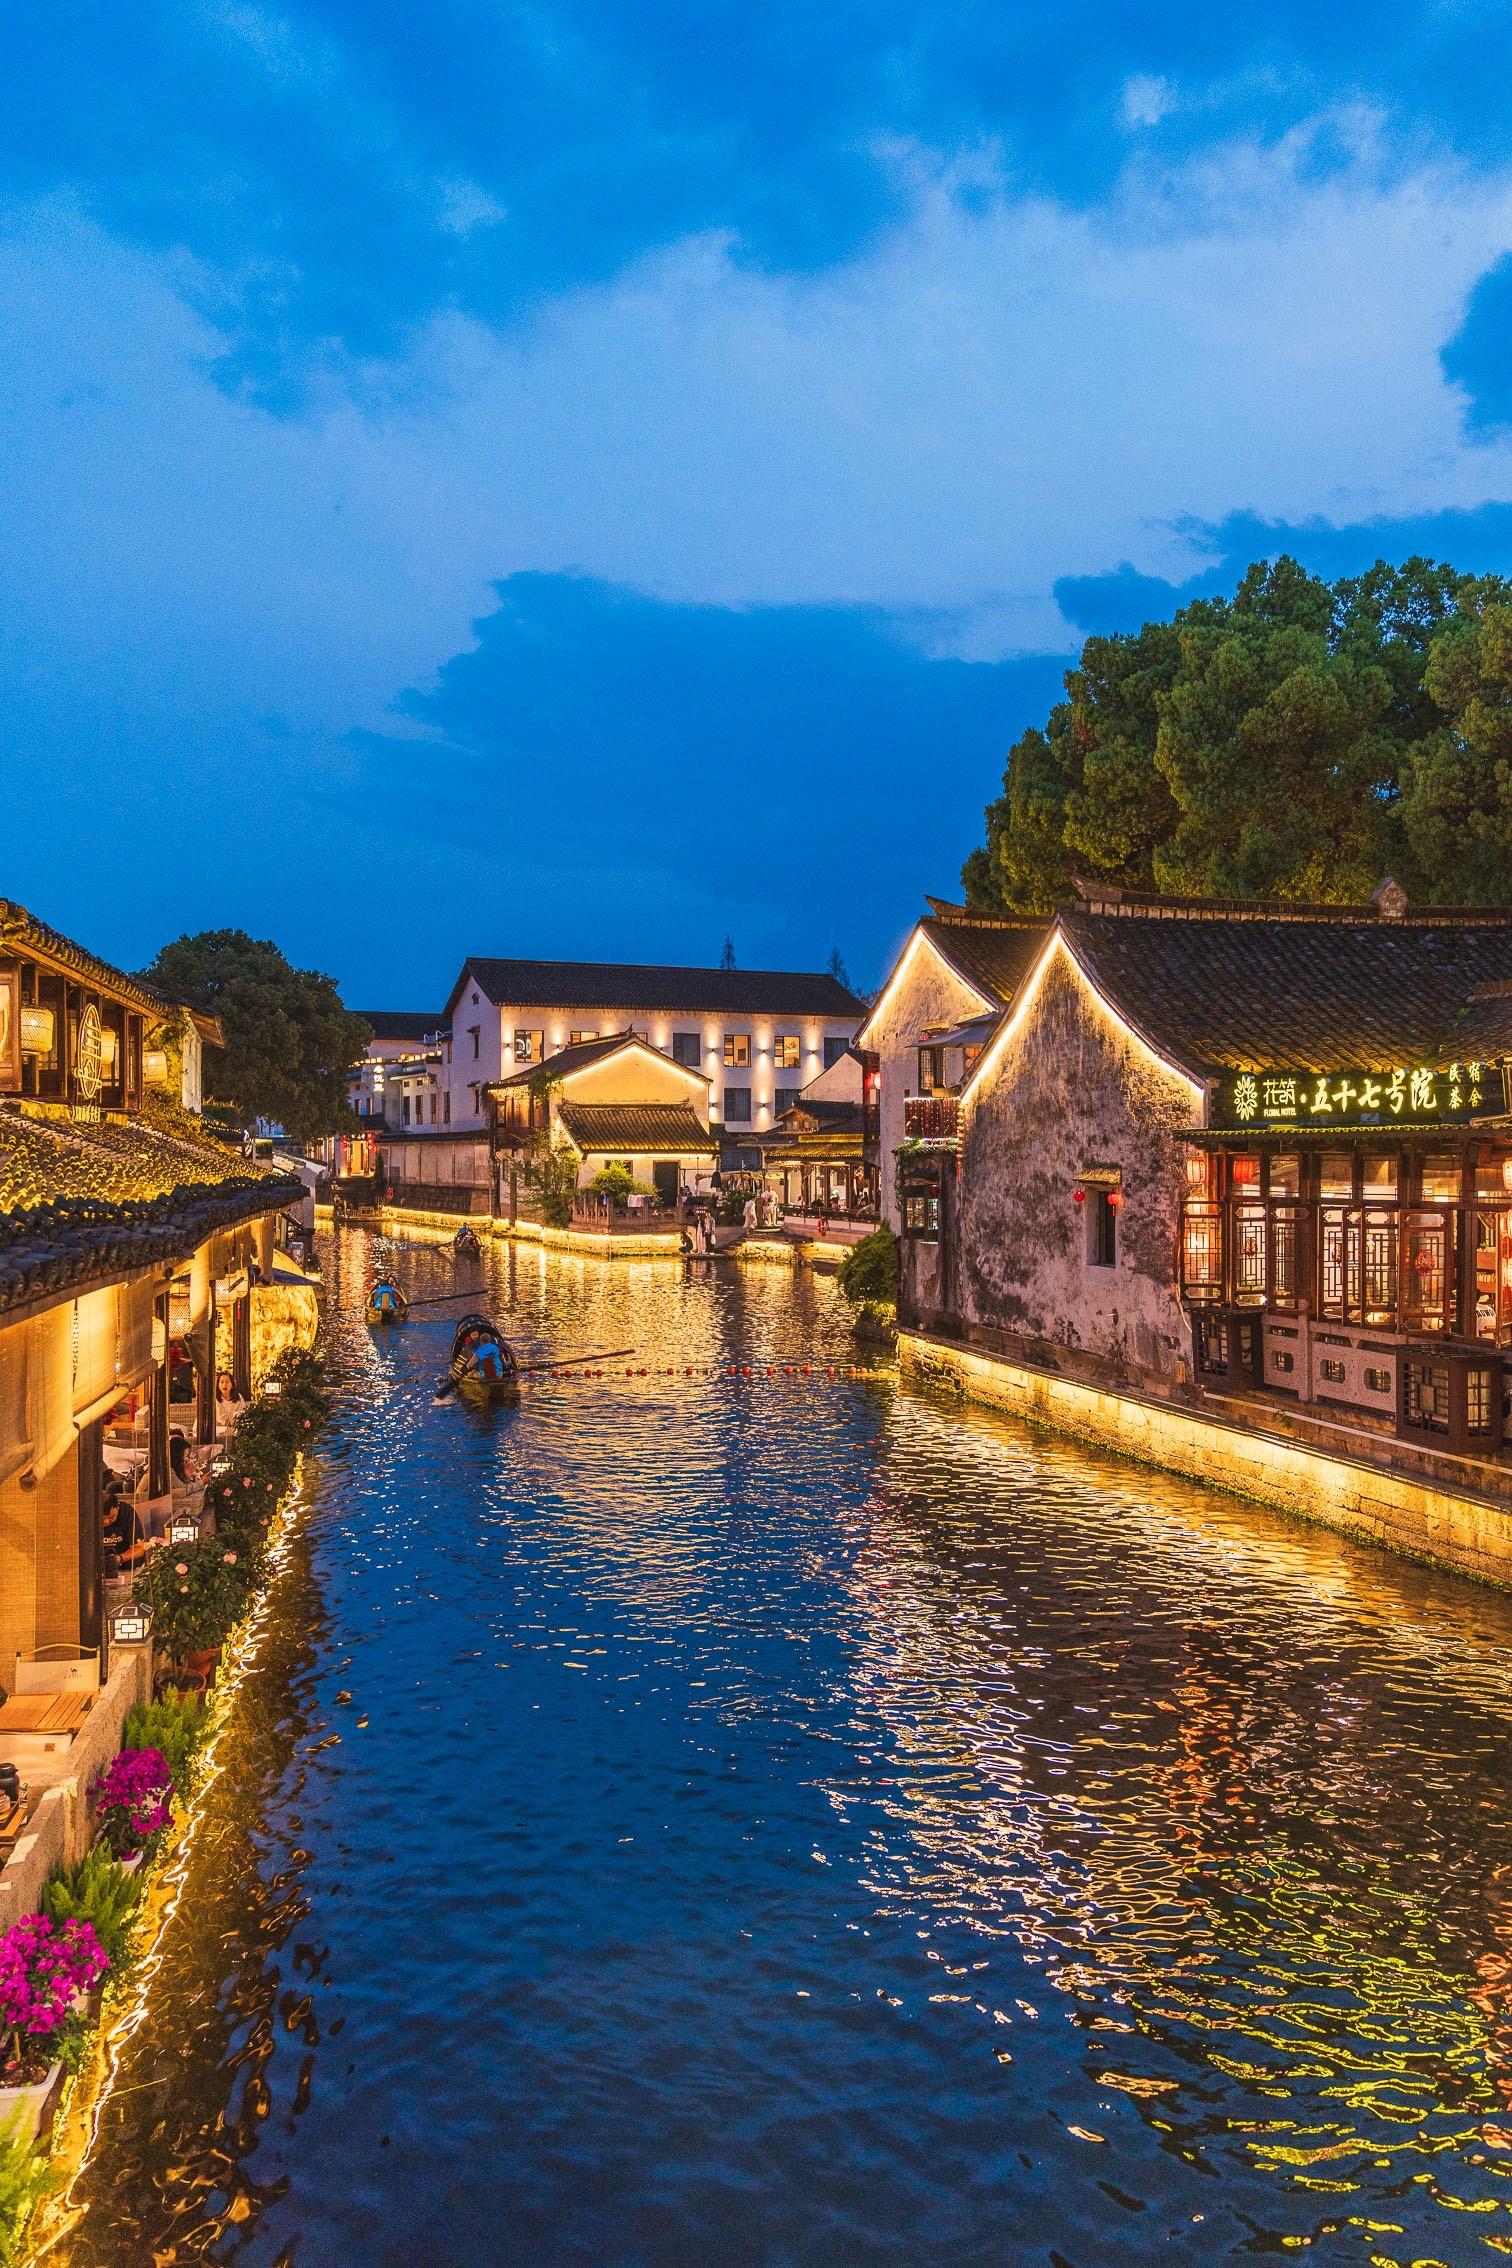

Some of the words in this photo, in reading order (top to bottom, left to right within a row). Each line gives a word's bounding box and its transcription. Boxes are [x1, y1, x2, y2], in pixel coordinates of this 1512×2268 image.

[1449, 1062, 1480, 1083] 民宿
[1263, 1078, 1296, 1105] 花筑
[1310, 1067, 1437, 1113] 五十七号院
[1448, 1086, 1483, 1109] 茶舍
[1263, 1108, 1280, 1117] FLORAL
[1281, 1107, 1296, 1116] HOTEL
